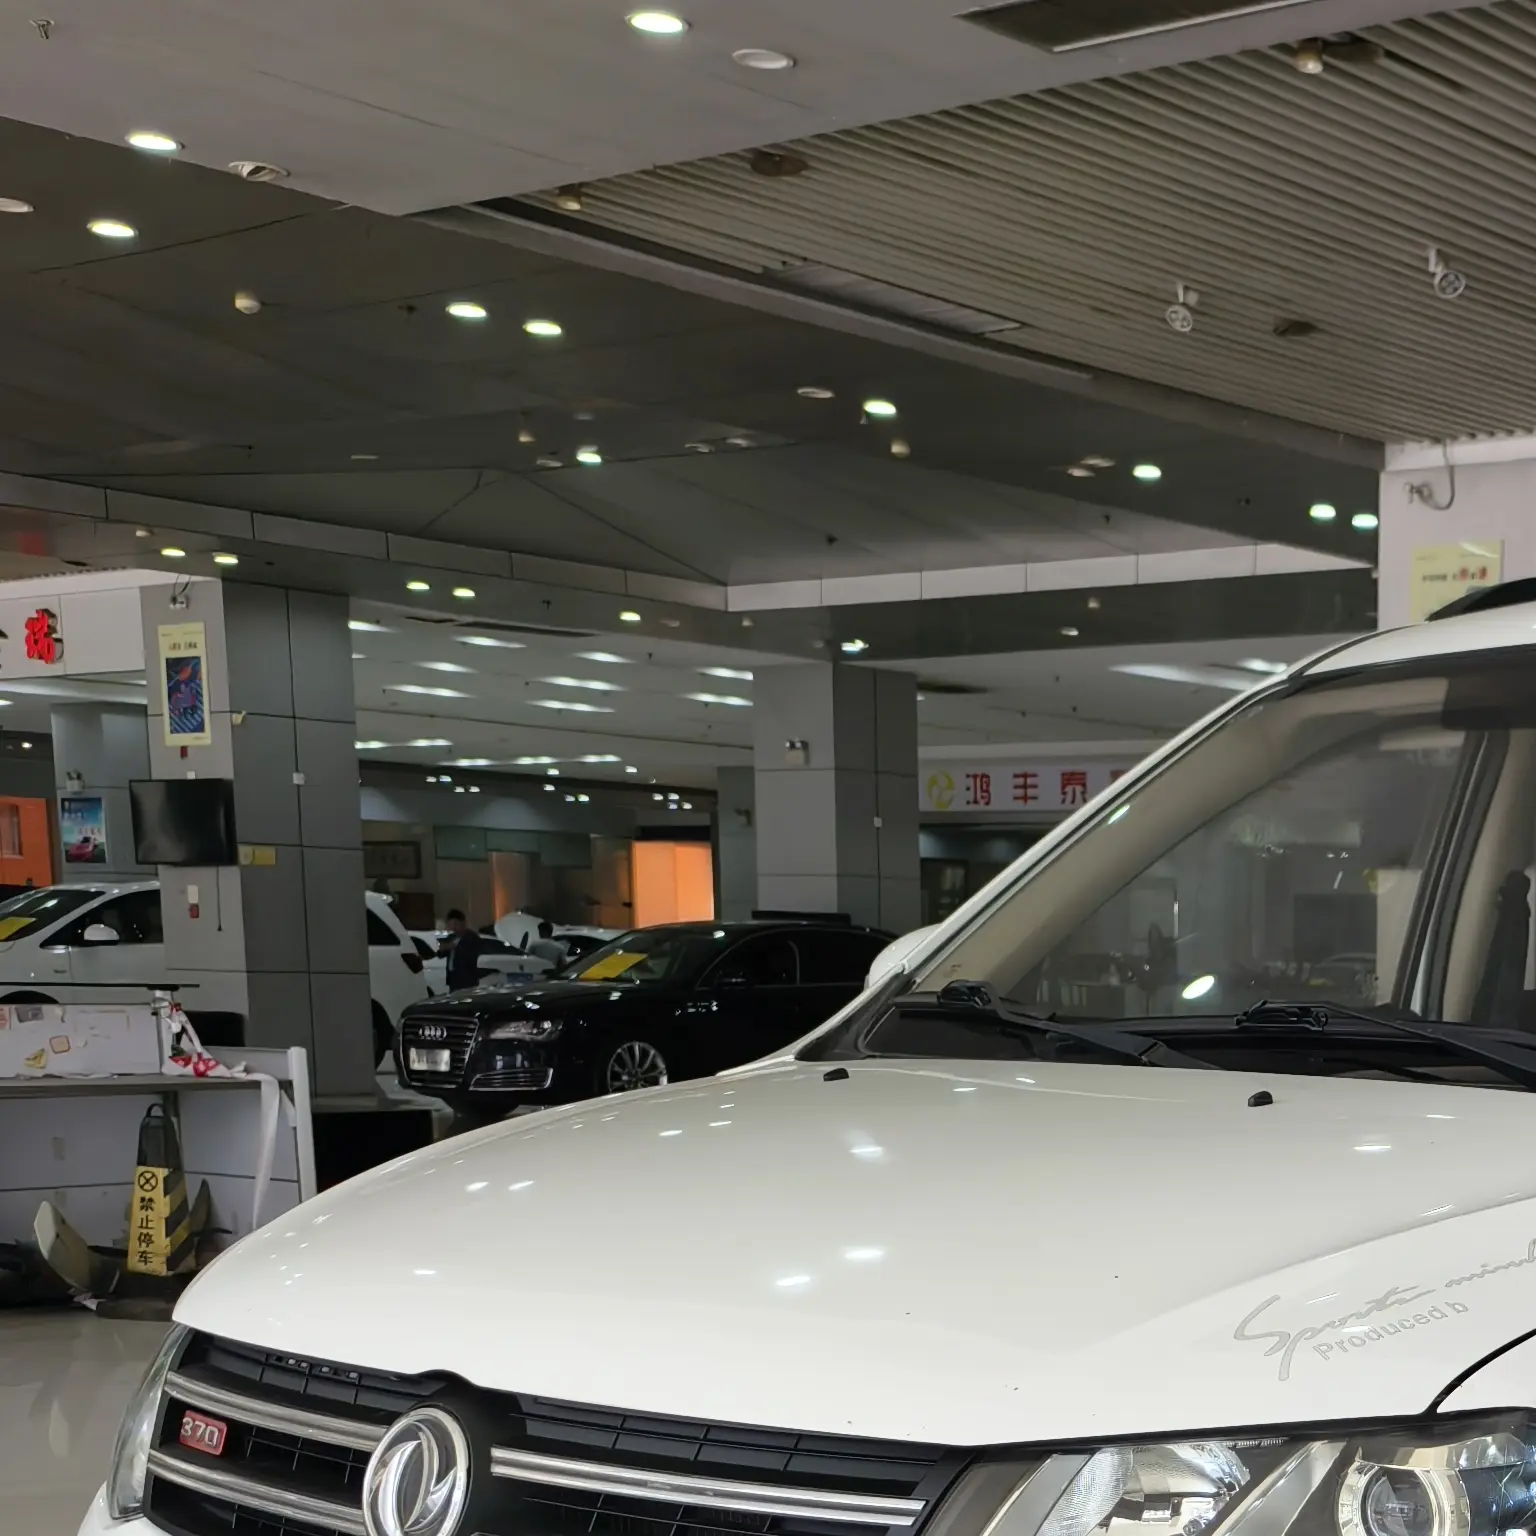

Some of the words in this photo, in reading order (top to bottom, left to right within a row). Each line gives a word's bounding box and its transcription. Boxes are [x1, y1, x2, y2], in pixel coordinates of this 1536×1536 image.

[137, 1196, 156, 1266] 禁止停车
[1312, 1304, 1448, 1361] Produced
[181, 1416, 219, 1448] 370
